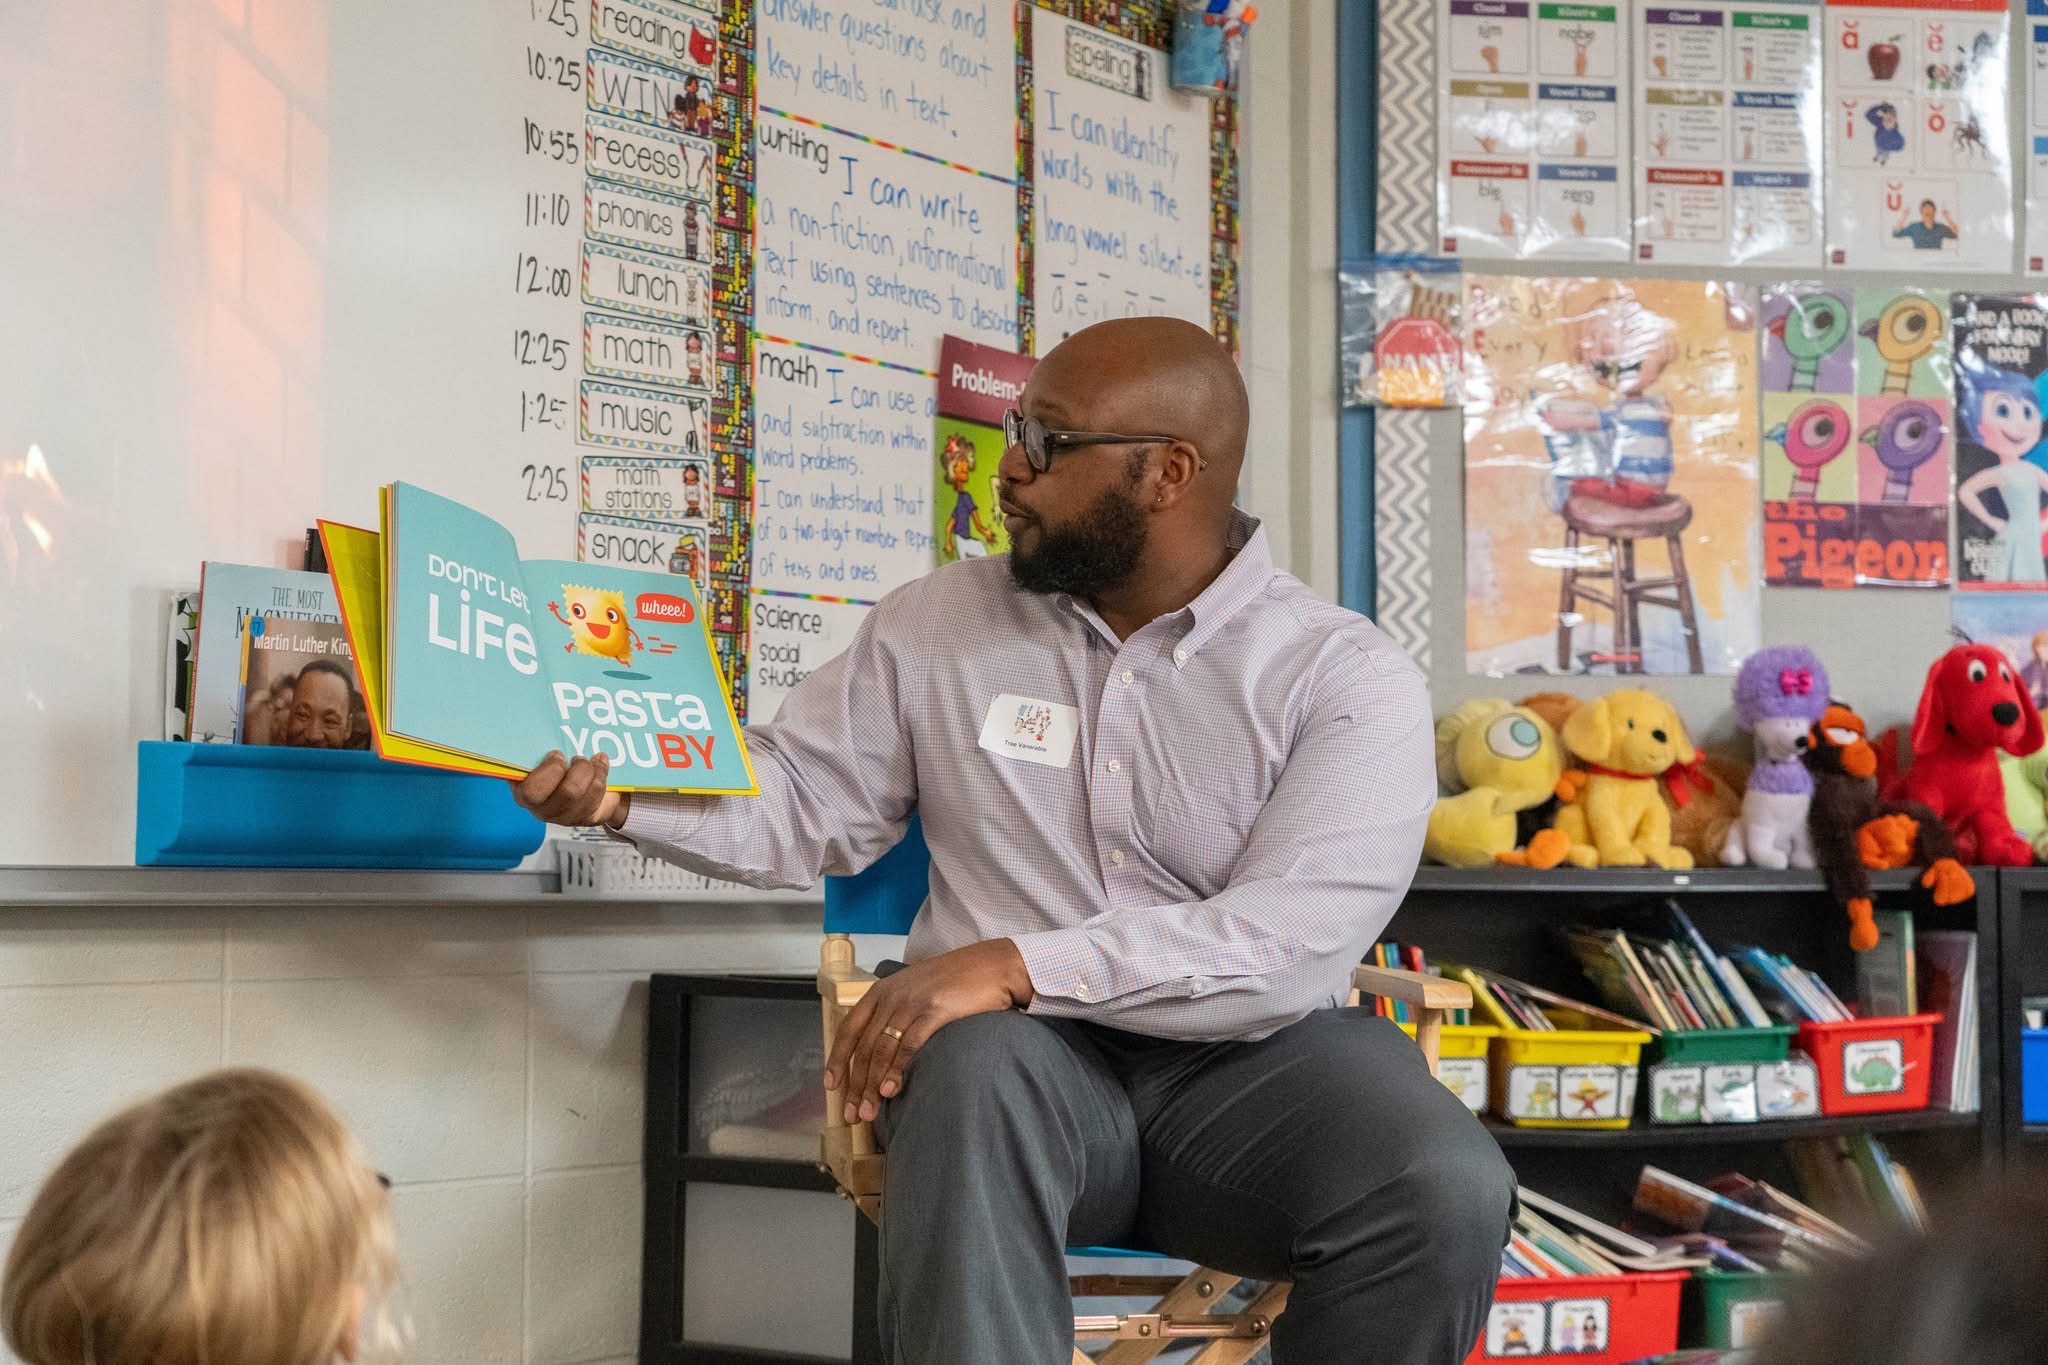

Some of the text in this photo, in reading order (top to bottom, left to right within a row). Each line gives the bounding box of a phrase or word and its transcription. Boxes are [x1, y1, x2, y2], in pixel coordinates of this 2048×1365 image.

[602, 5, 686, 59] reading
[762, 0, 993, 87] answer questions about
[951, 3, 988, 40] and
[527, 46, 581, 92] 10:25
[766, 36, 801, 96] key
[811, 53, 866, 103] details
[879, 78, 899, 113] in
[1070, 40, 1132, 87] spelling
[602, 68, 671, 121] WIN
[524, 117, 578, 164] 10:55
[592, 135, 682, 180] recess
[759, 123, 829, 175] writing
[1044, 88, 1180, 185] I can identify
[525, 191, 571, 227] 11:10
[839, 155, 982, 235] I can write
[1105, 169, 1142, 206] with
[1149, 178, 1181, 222] the
[597, 199, 674, 237] phonics
[1043, 193, 1079, 267] long
[1081, 227, 1128, 262] vowel
[760, 198, 775, 226] a
[906, 227, 1007, 291] informational
[515, 252, 571, 297] 12:00
[617, 263, 678, 306] lunch
[759, 237, 799, 280] text
[810, 258, 858, 305] using
[865, 273, 942, 316] sentences
[948, 283, 967, 321] to
[828, 307, 860, 335] and
[515, 330, 570, 370] 12:25
[603, 334, 672, 369] math
[759, 351, 818, 389] math
[825, 368, 845, 404] I
[850, 385, 880, 409] can
[887, 388, 917, 414] use
[601, 401, 673, 436] music
[760, 405, 793, 437] and
[801, 411, 885, 446] subtraction
[616, 465, 661, 486] math
[605, 489, 673, 509] stations
[758, 479, 926, 517] I can understand that
[592, 533, 666, 566] snack
[783, 557, 812, 581] tens
[819, 558, 845, 582] and
[1763, 521, 1950, 589] Pigeon
[271, 586, 325, 611] THE MOST
[640, 600, 687, 618] wheee!
[754, 602, 822, 634] Science
[253, 633, 289, 651] Martin
[292, 634, 329, 654] Luther
